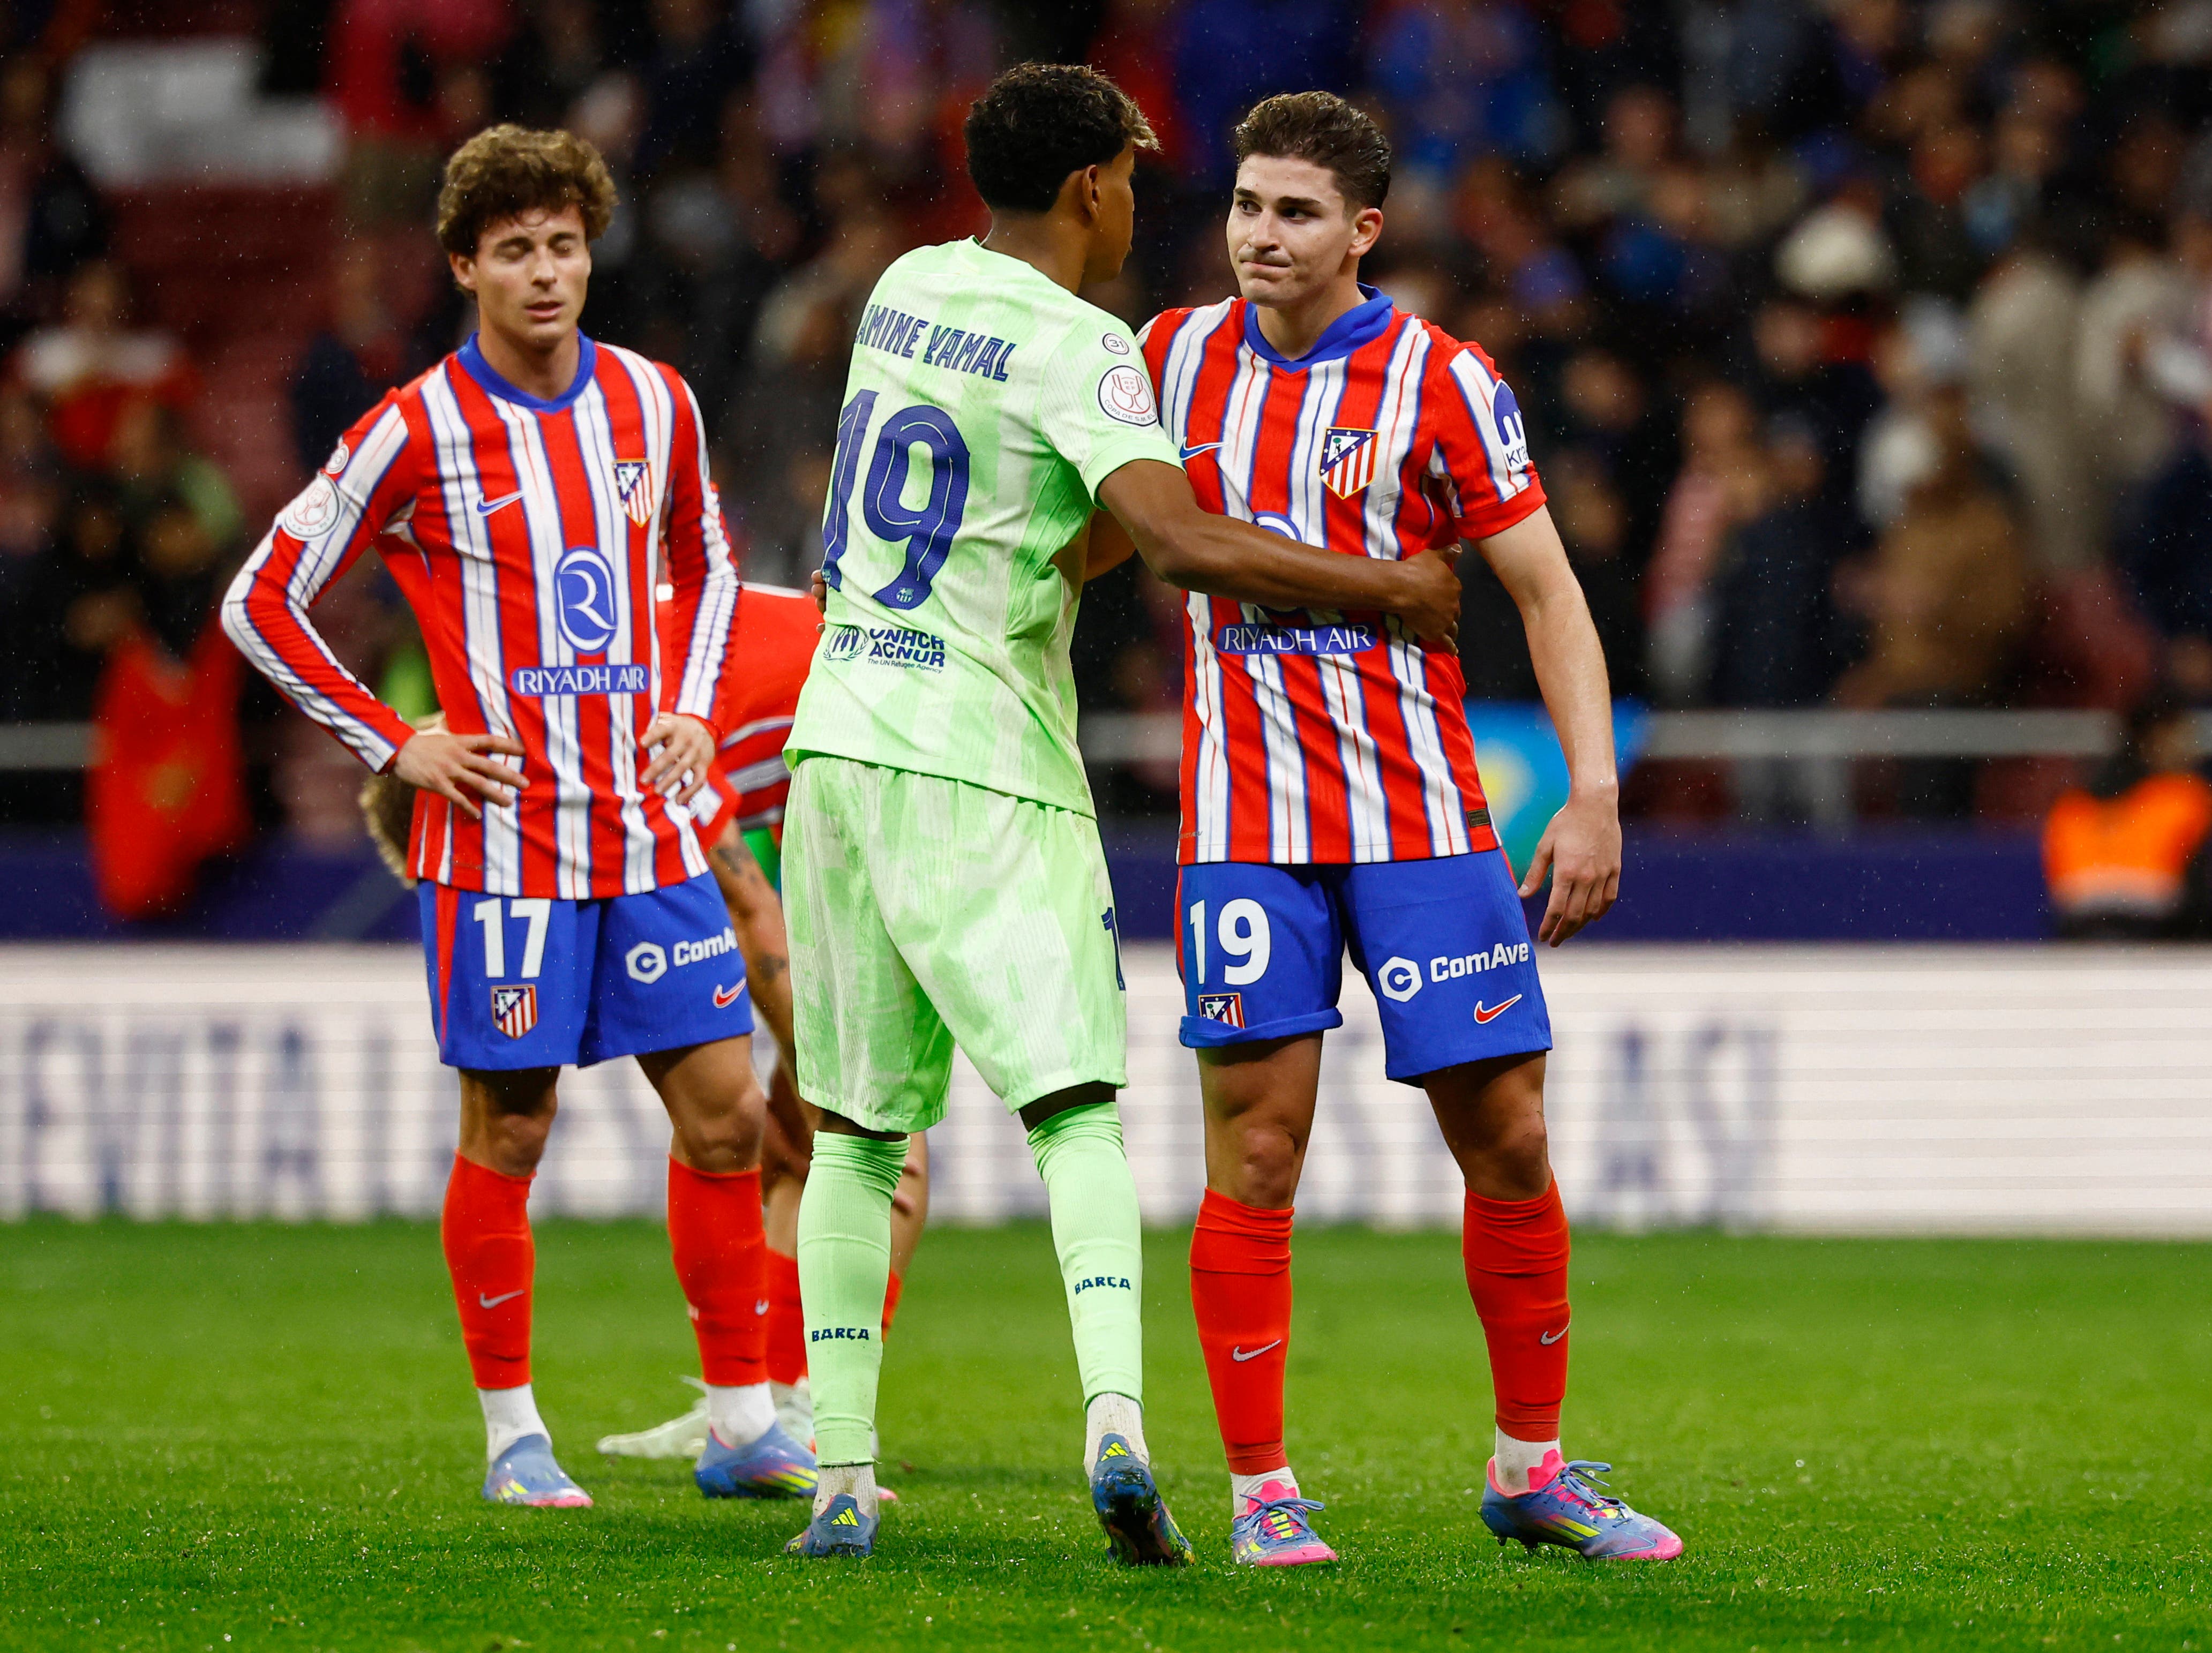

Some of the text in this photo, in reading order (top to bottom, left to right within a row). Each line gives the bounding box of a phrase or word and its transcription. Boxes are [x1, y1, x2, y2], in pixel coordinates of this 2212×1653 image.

[855, 304, 1017, 382] AMINE YAMAL
[1108, 339, 1124, 348] 31
[1104, 399, 1121, 416] COPA
[822, 389, 970, 611] 19
[1224, 625, 1372, 651] RIYADH AIR
[868, 641, 946, 667] ACNUR
[891, 660, 915, 668] Refugee
[916, 664, 943, 674] Agency
[518, 666, 645, 694] RIYADH AIR
[474, 898, 551, 978] 17
[673, 926, 738, 967] ComA
[1190, 898, 1271, 985] 19
[1430, 943, 1529, 983] ComAve
[1075, 1276, 1131, 1295] BARÇA
[812, 1327, 869, 1342] BARÇA
